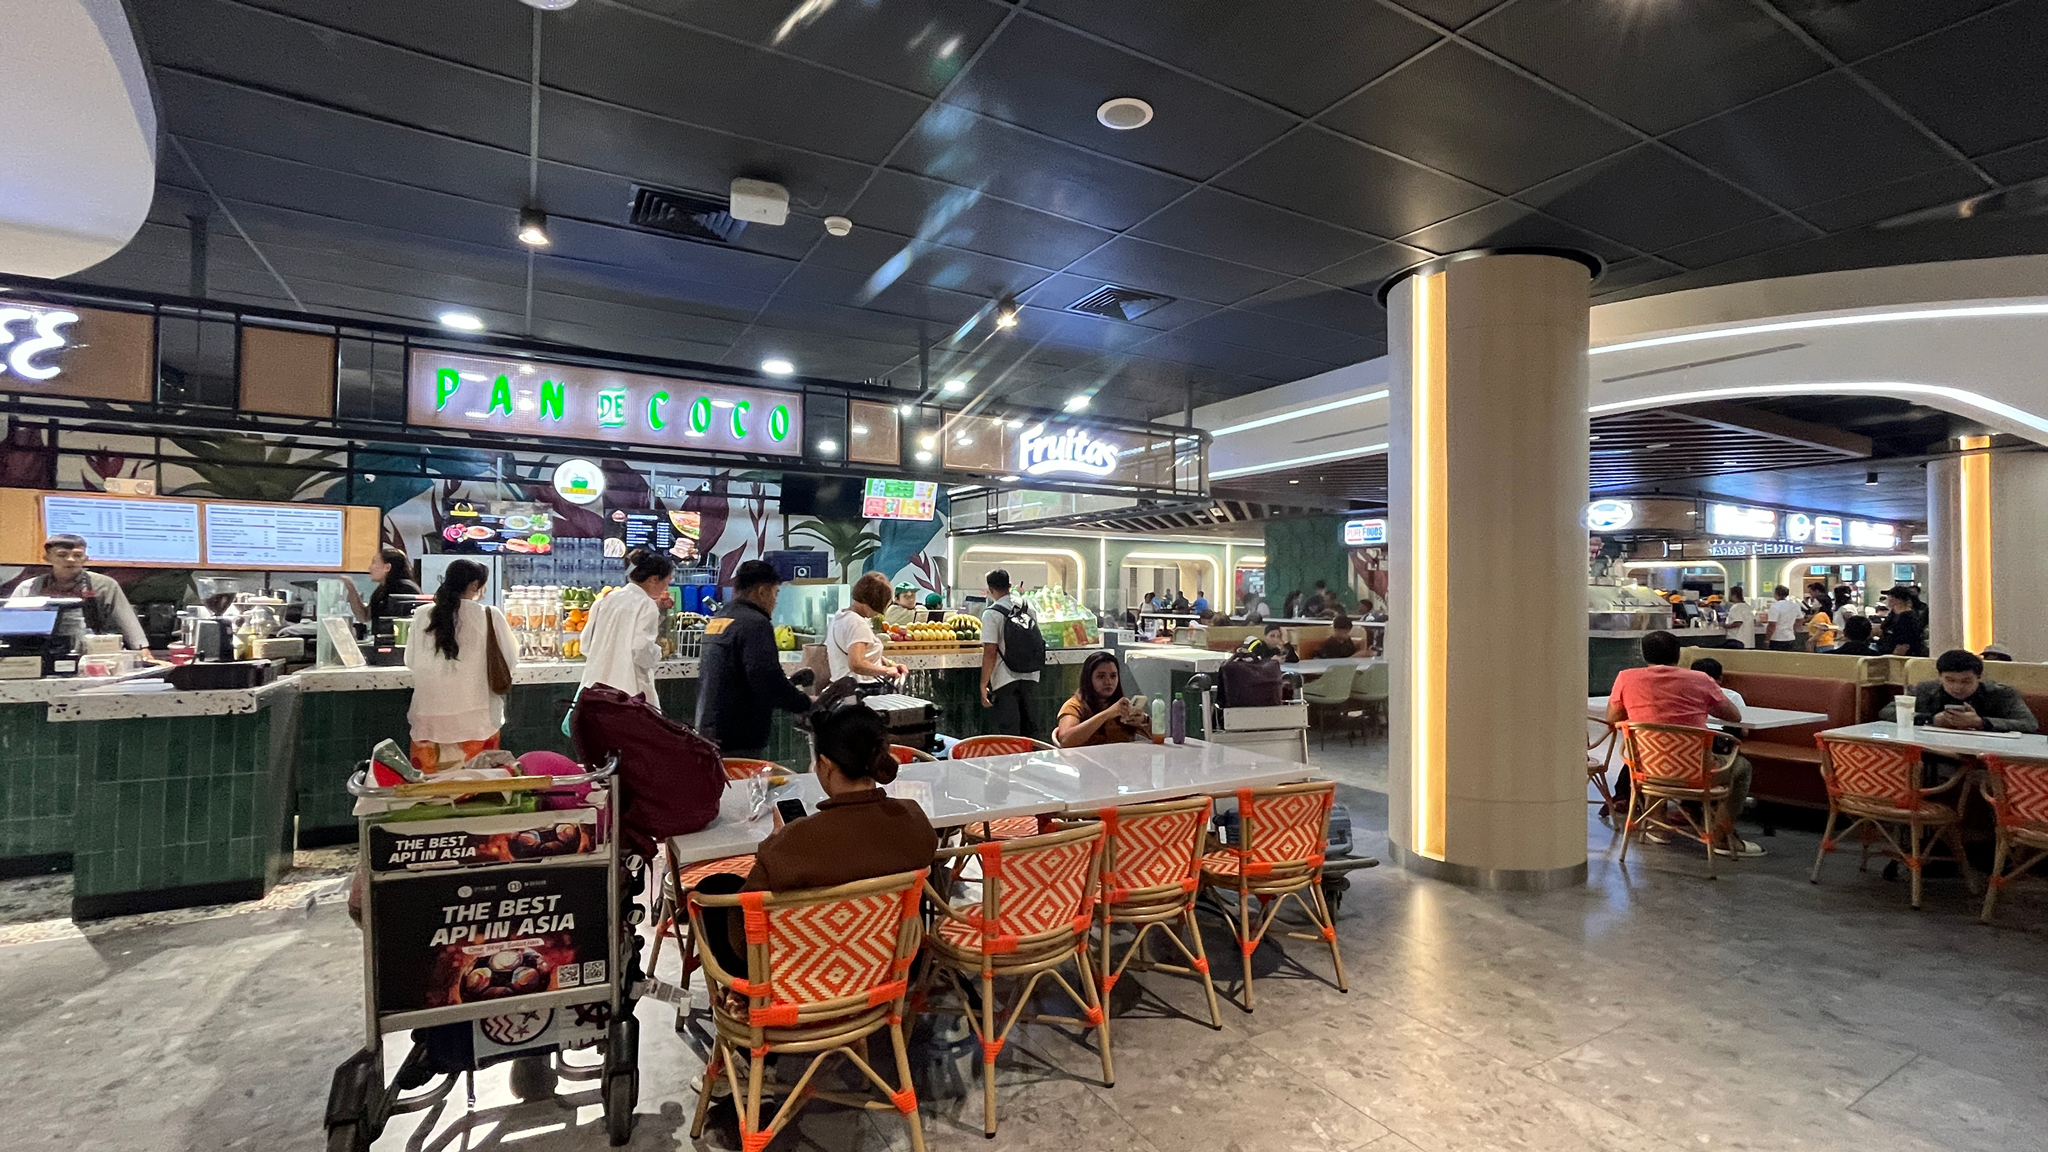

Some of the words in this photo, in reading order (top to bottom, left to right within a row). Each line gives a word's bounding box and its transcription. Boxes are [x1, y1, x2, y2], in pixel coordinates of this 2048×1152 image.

[436, 367, 565, 422] PAN
[598, 391, 626, 422] DE
[647, 390, 790, 441] COCO
[1019, 423, 1119, 475] Fruitas
[388, 851, 417, 864] API
[420, 849, 437, 861] IN
[440, 846, 477, 860] ASIA
[395, 839, 425, 851] THE
[428, 835, 468, 849] BEST
[442, 901, 492, 924] THE
[497, 894, 562, 918] BEST
[430, 924, 478, 947] API
[483, 920, 511, 941] IN
[515, 912, 575, 937] ASIA
